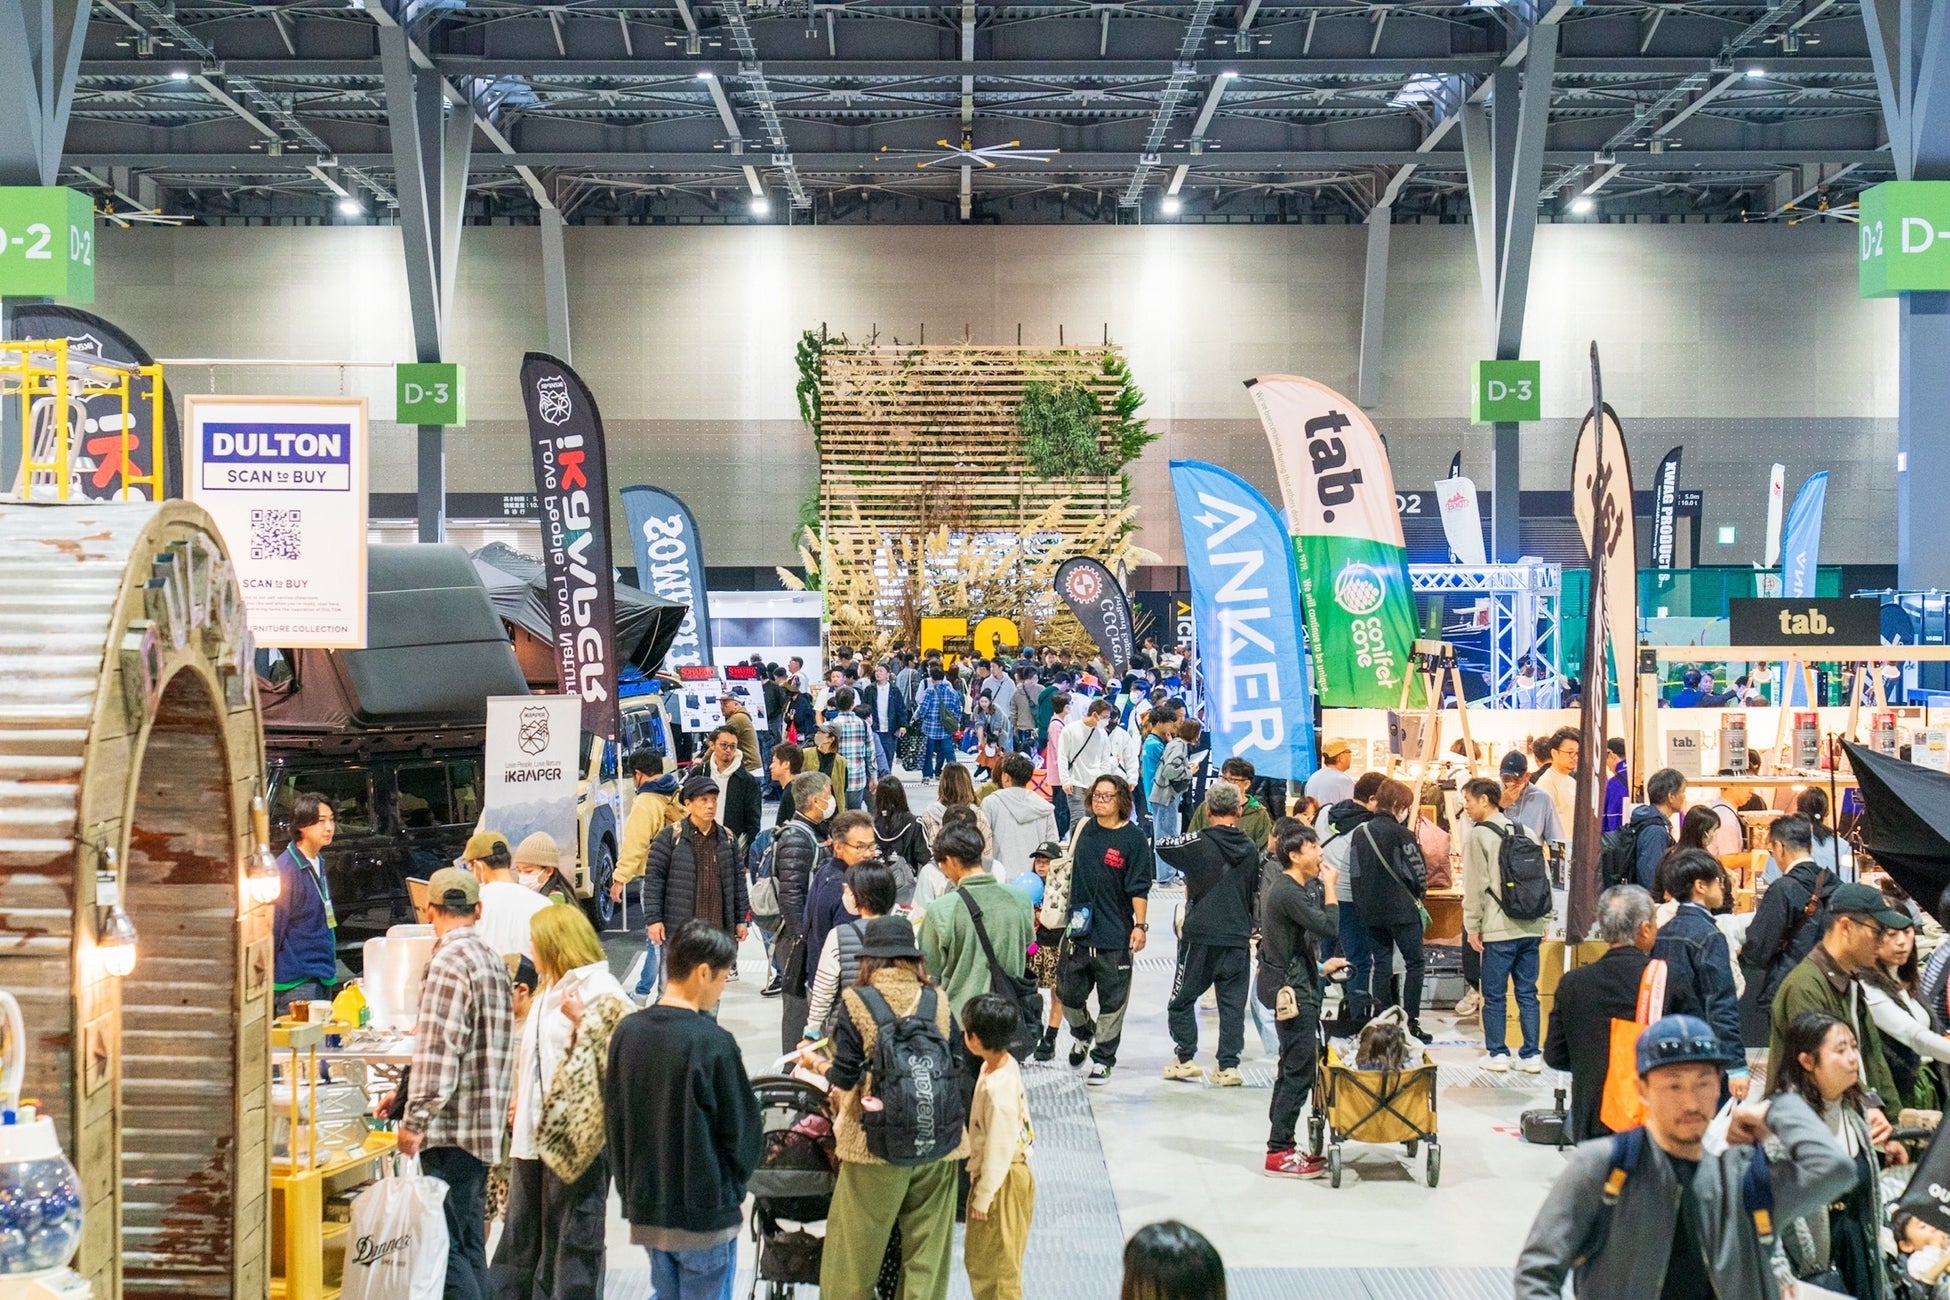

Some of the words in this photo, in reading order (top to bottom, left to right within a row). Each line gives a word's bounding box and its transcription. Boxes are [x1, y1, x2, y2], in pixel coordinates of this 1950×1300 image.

[70, 224, 91, 266] D-2
[1862, 220, 1883, 261] D-2
[405, 383, 449, 404] D-3
[1488, 380, 1532, 401] D-3
[213, 433, 341, 457] DULTON
[228, 470, 272, 482] SCAN
[277, 471, 288, 482] to
[293, 471, 326, 483] BUY
[1305, 410, 1363, 523] tab.
[1663, 461, 1677, 504] XWAG
[1299, 554, 1308, 571] 1919.
[243, 580, 272, 588] SCAN
[286, 580, 308, 588] BUY
[1303, 578, 1312, 592] We
[1306, 593, 1316, 607] will
[250, 625, 290, 633] RNITURE
[1193, 491, 1285, 757] ANKER
[1308, 608, 1321, 643] continue
[1779, 608, 1835, 635] tab.
[1314, 644, 1322, 652] to
[1351, 619, 1372, 668] cone
[1366, 617, 1400, 688] conifer
[1315, 653, 1324, 664] be
[1673, 737, 1696, 747] tab.
